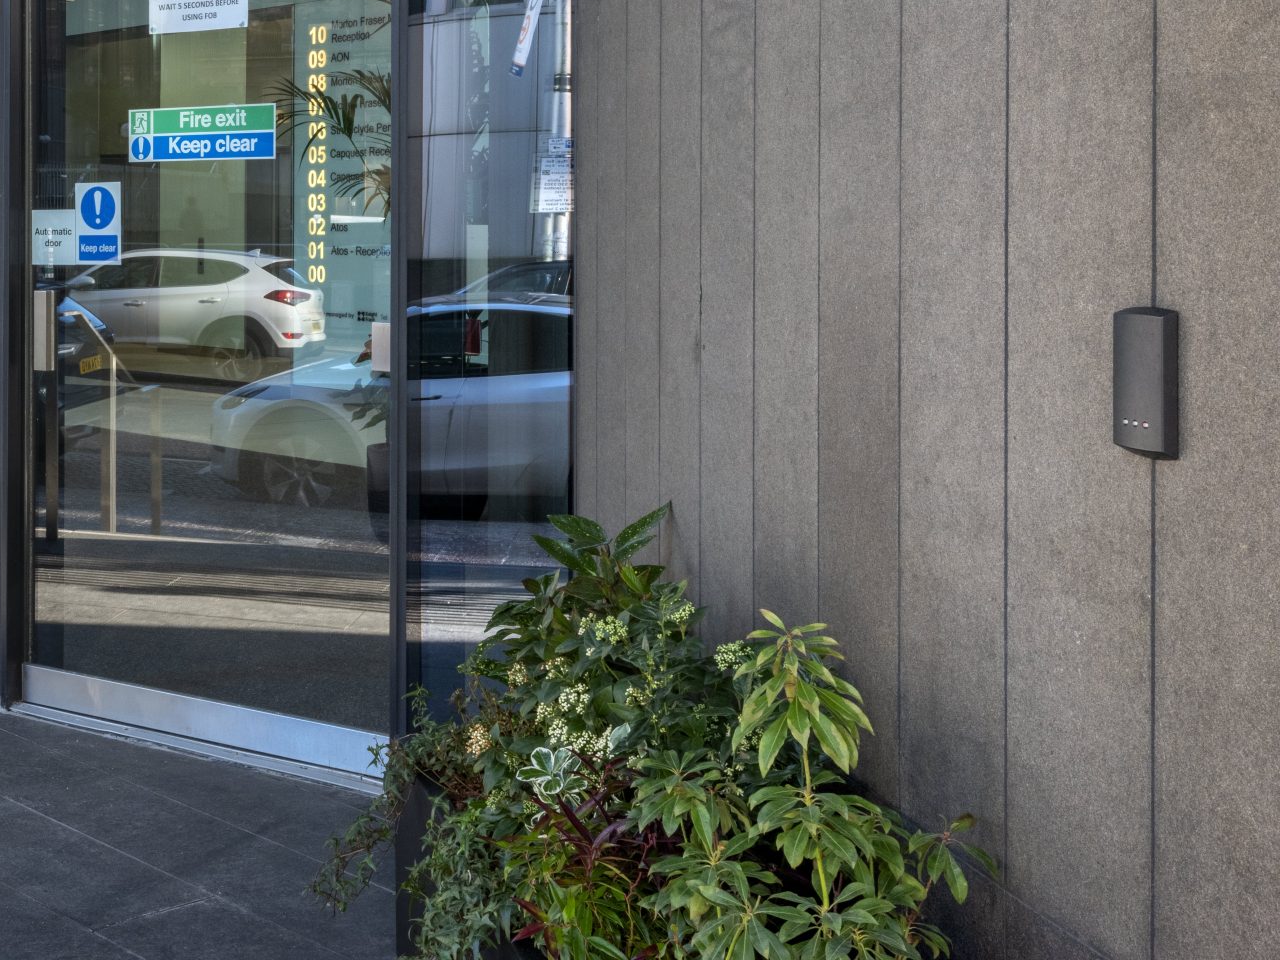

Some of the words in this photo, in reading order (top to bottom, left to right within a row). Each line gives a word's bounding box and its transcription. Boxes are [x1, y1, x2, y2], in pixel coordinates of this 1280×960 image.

[158, 3, 177, 11] WAIT
[177, 2, 182, 10] 5
[183, 0, 214, 9] SECONDS
[182, 13, 203, 21] USING
[204, 11, 218, 20] FOB
[309, 25, 327, 45] 10
[360, 16, 386, 26] Fraser
[331, 30, 370, 43] Reception
[308, 49, 327, 69] 09
[330, 52, 350, 63] AON
[308, 73, 327, 92] 08
[179, 111, 212, 129] Fire
[215, 109, 247, 128] exit
[308, 121, 327, 140] 06
[168, 136, 212, 158] Keep
[215, 135, 258, 153] clear
[308, 146, 326, 164] 05
[369, 146, 392, 158] Rece
[307, 169, 326, 188] 04
[308, 193, 326, 212] 03
[308, 217, 326, 236] 02
[330, 223, 349, 233] Atos
[44, 239, 62, 247] door
[80, 243, 98, 254] Keep
[98, 243, 117, 252] clear
[308, 241, 324, 259] 01
[331, 246, 349, 256] Atos
[308, 265, 326, 283] 00
